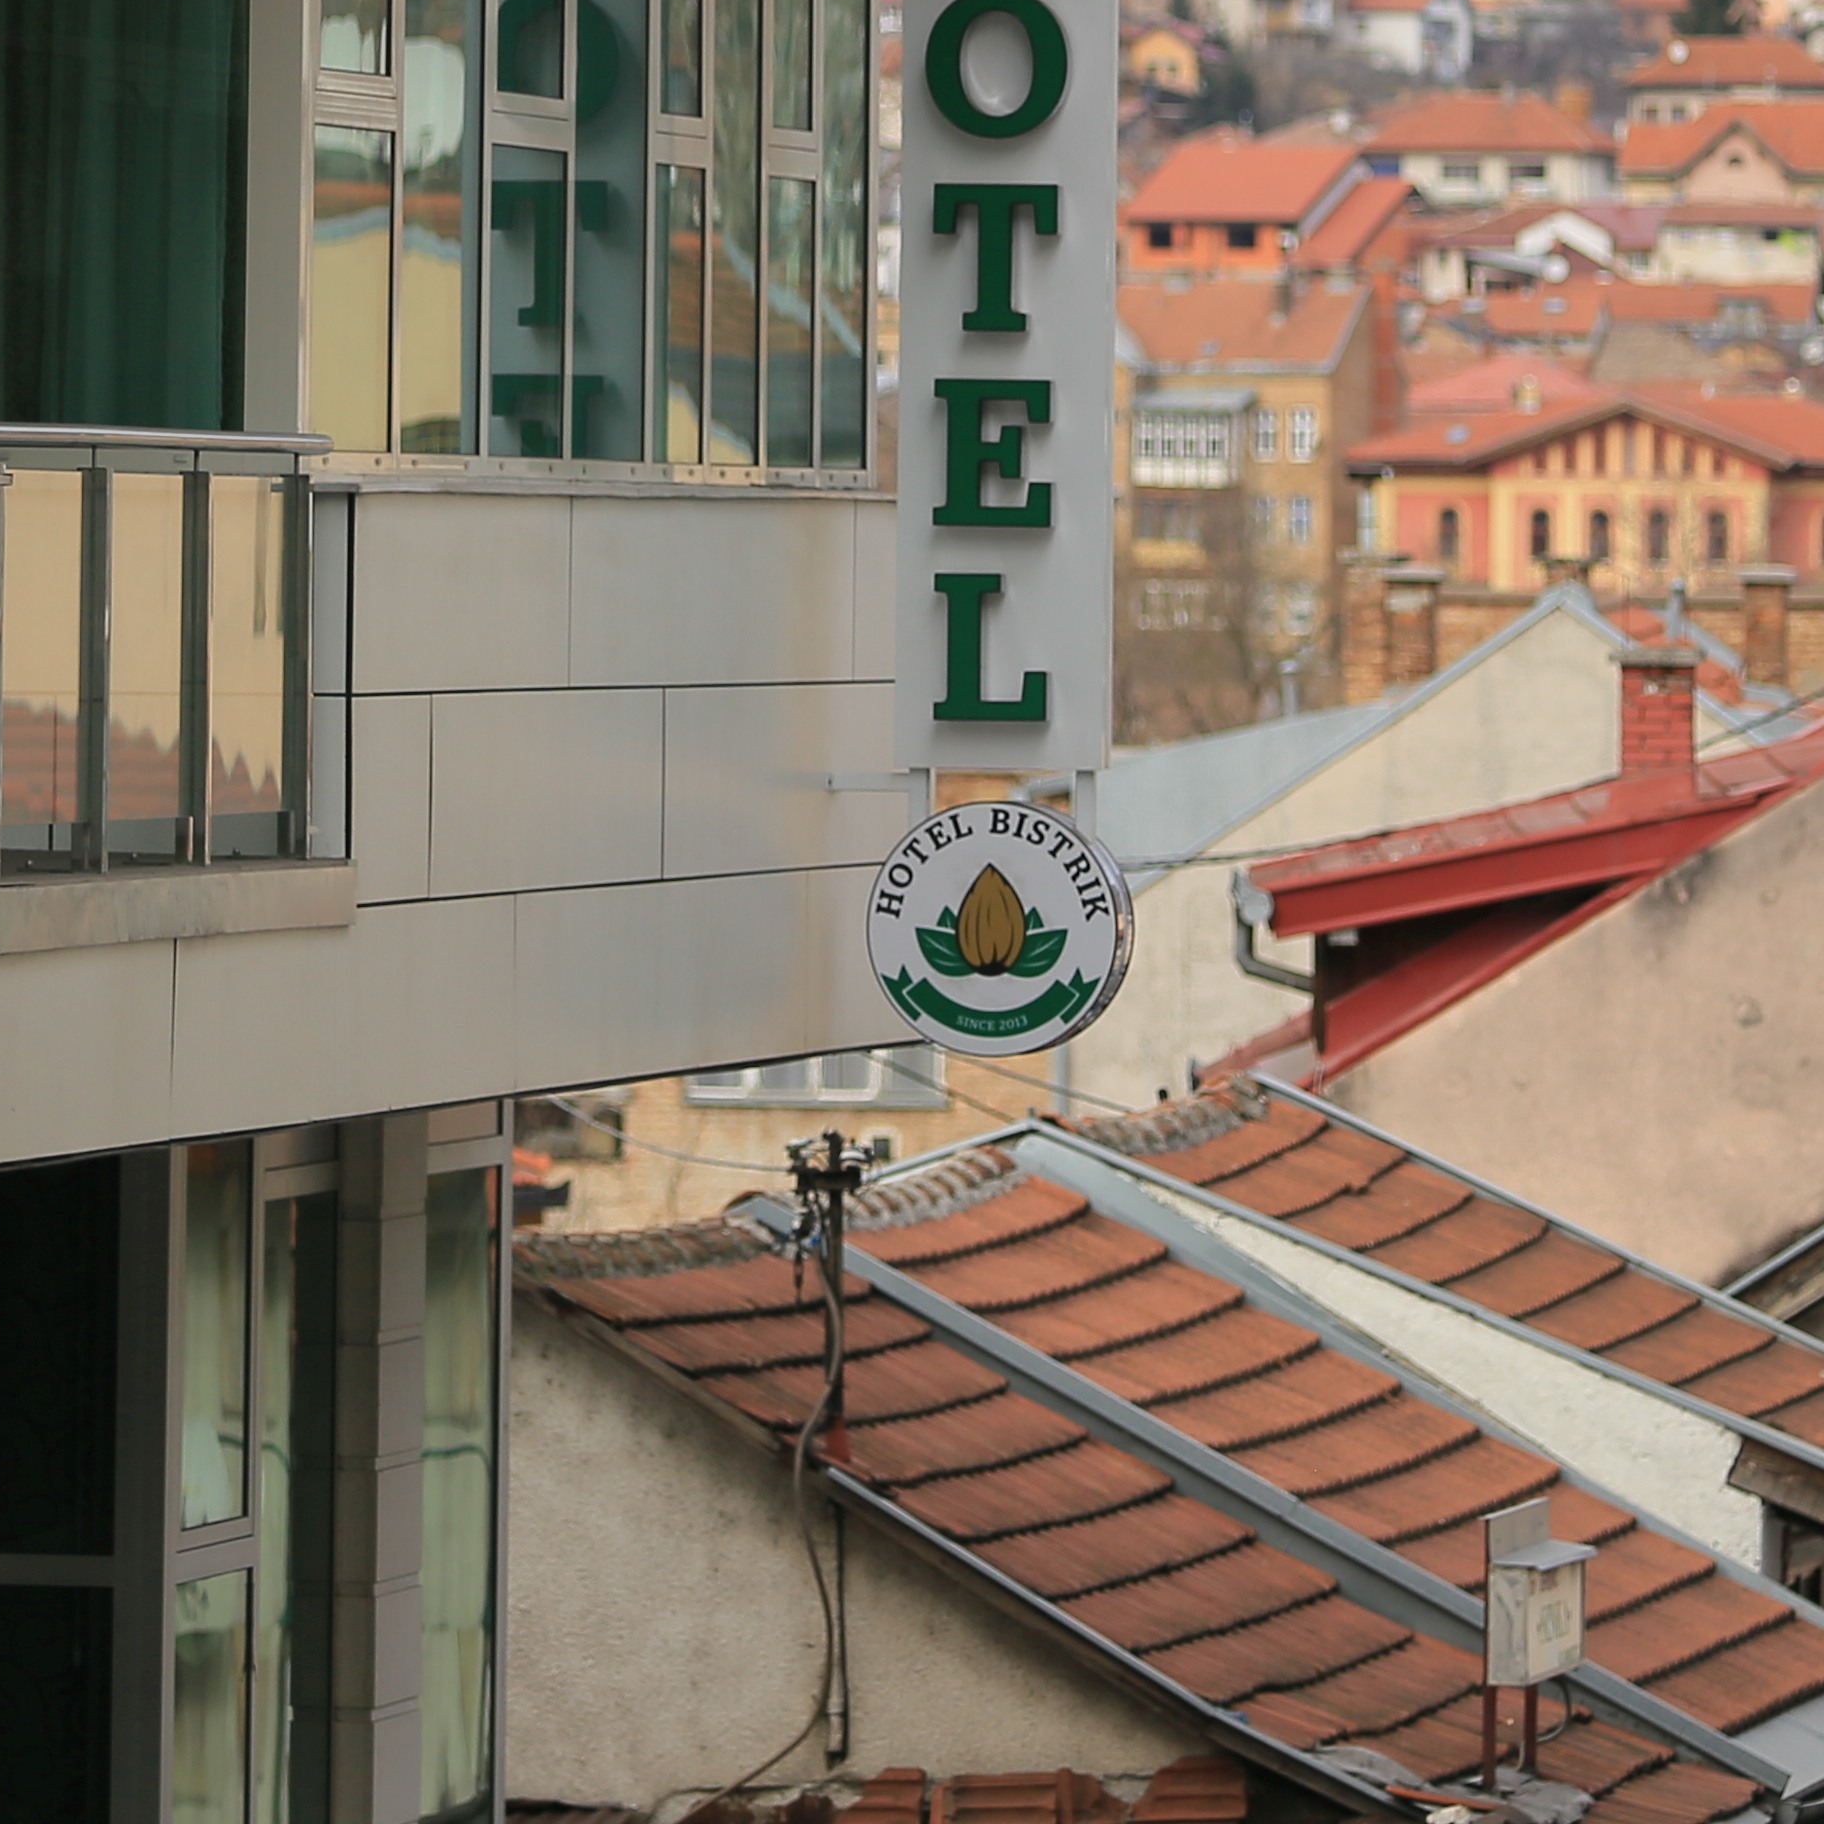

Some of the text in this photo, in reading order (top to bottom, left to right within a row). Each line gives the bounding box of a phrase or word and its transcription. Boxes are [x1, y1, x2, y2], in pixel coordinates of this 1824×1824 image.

[875, 808, 1110, 922] HOTEL BISTRIK
[956, 1014, 1028, 1031] SINCE 2013
